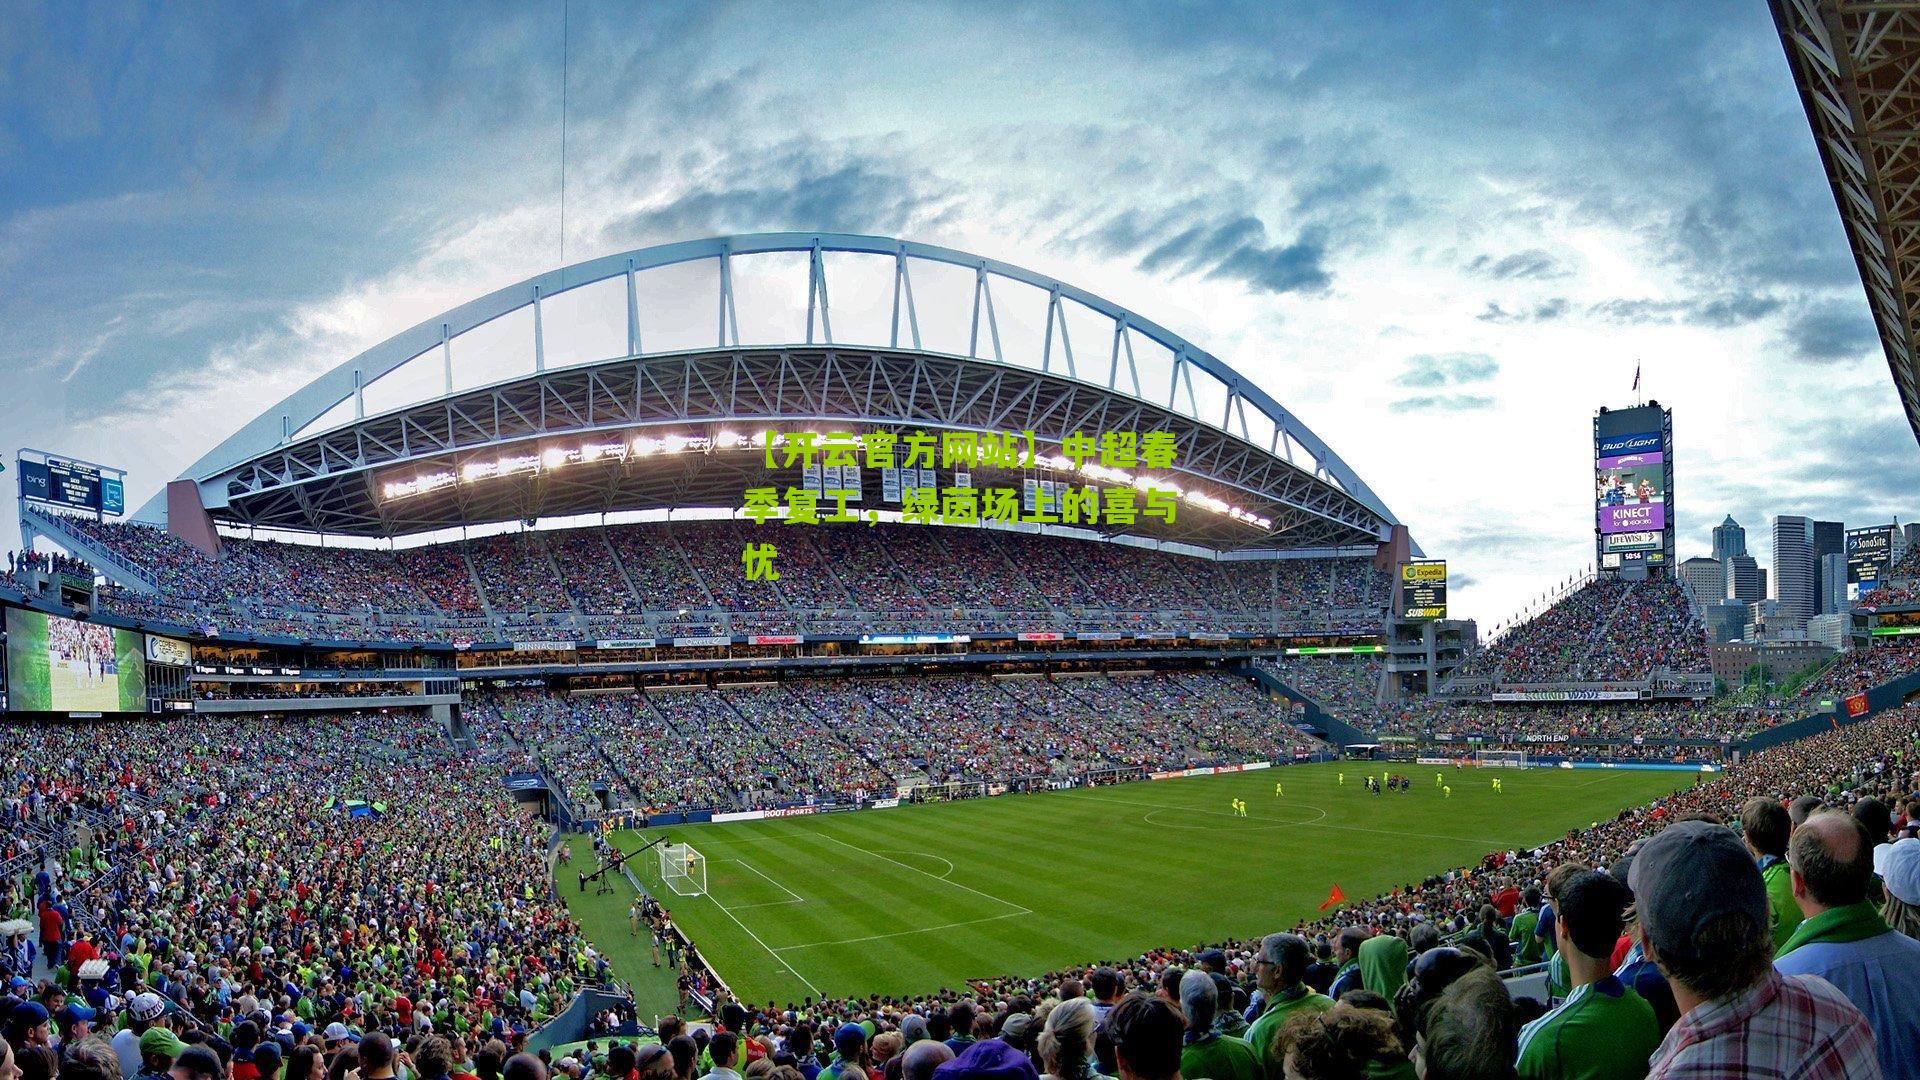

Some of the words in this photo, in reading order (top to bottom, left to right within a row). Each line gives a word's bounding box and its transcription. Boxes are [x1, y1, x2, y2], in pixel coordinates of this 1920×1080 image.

[1602, 442, 1624, 450] BUD
[1628, 439, 1658, 447] LIGHT
[26, 475, 46, 488] bing
[1613, 507, 1652, 519] KINECT
[1858, 535, 1886, 548] SonoSite
[1405, 608, 1444, 617] SUBWAY
[519, 642, 566, 650] PINNACLE
[764, 809, 786, 817] ROOT
[786, 807, 813, 816] SPORTS
